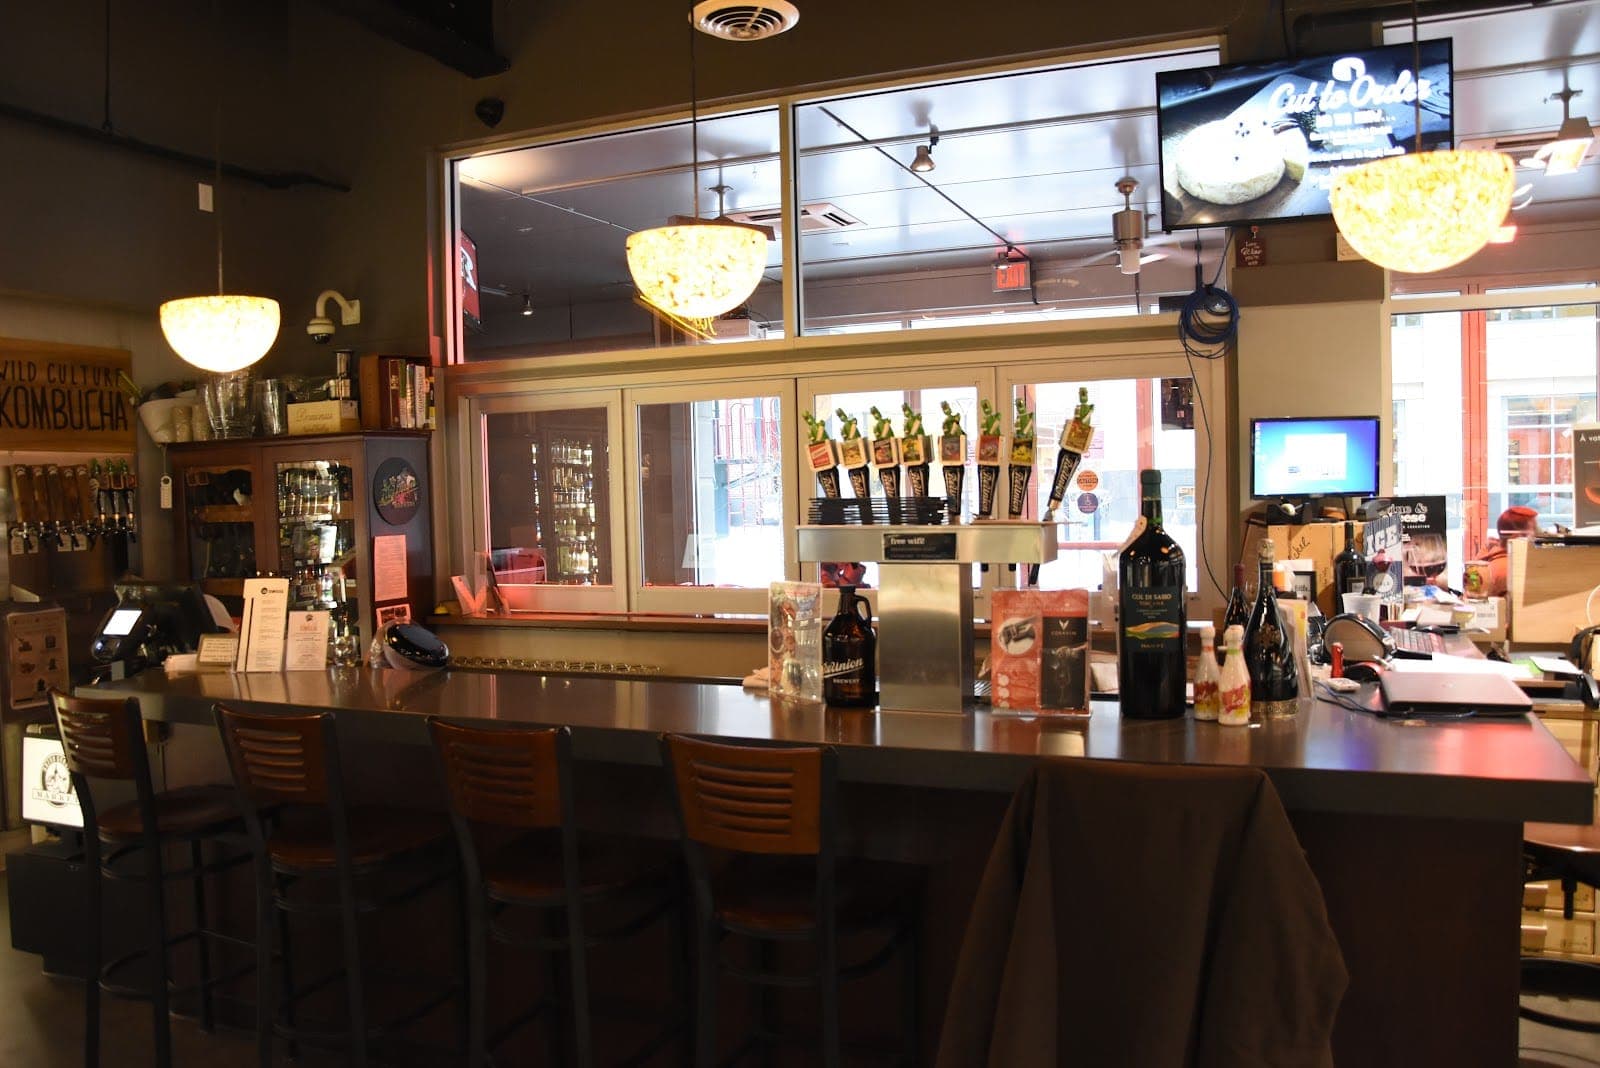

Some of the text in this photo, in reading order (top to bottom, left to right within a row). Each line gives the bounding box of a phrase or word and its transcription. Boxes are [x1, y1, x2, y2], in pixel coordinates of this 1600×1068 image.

[1268, 69, 1432, 114] Cut to Order
[0, 385, 128, 431] KOMBUCHA
[1366, 523, 1398, 556] ICE
